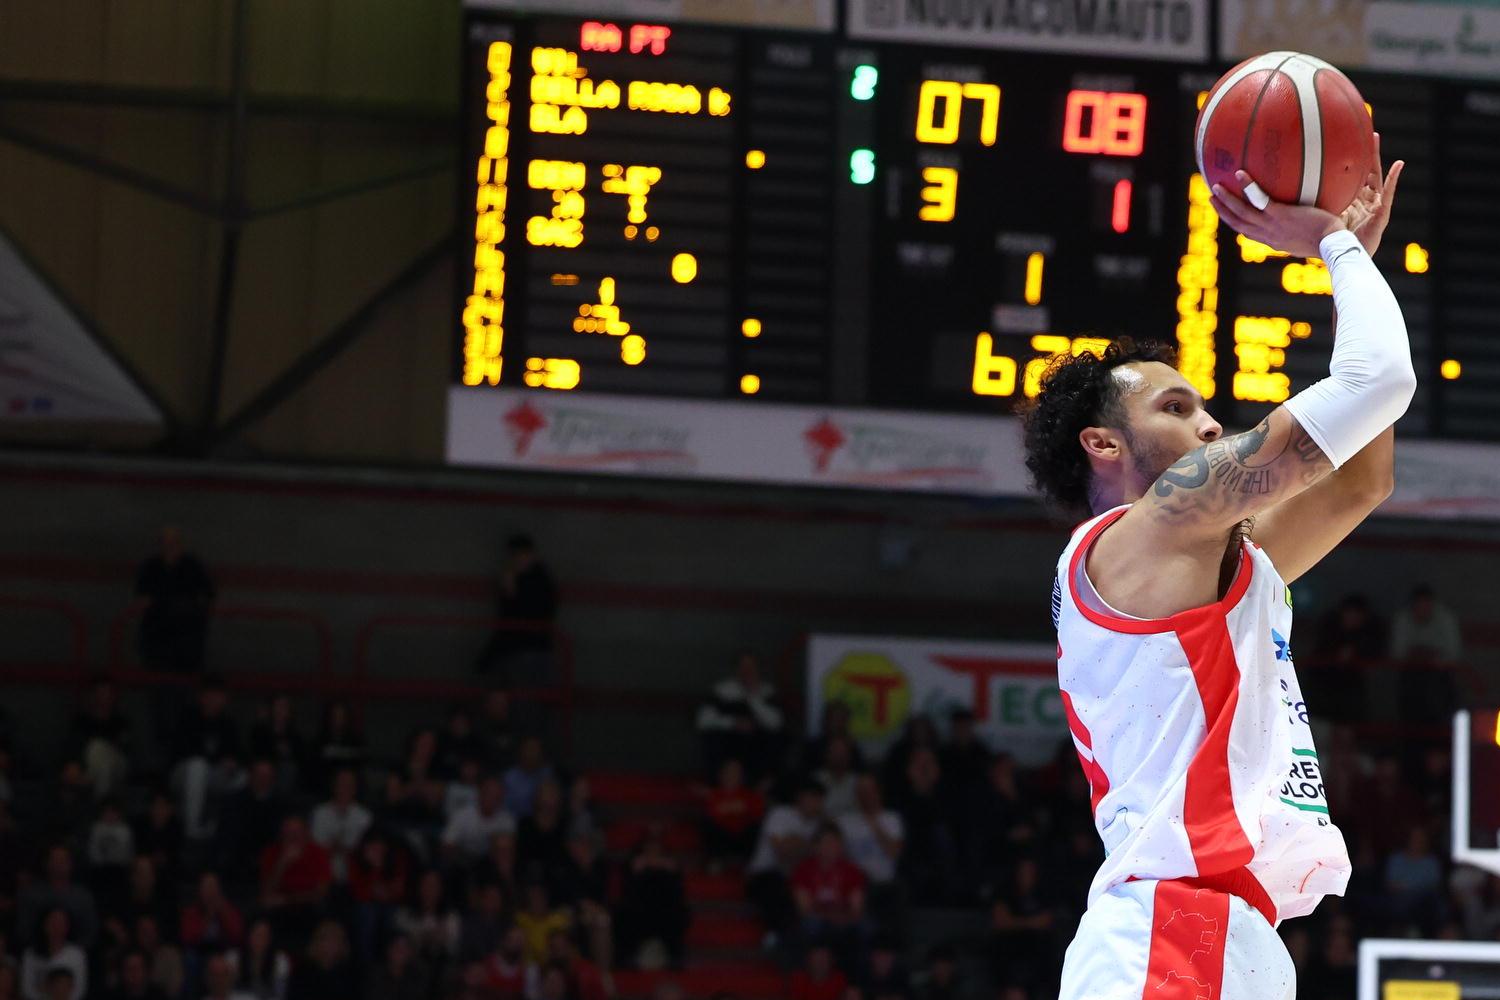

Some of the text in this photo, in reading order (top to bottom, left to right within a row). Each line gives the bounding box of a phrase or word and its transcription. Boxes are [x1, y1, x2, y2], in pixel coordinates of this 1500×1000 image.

[916, 80, 1001, 147] 07
[1063, 89, 1148, 156] 08
[918, 167, 959, 223] 3
[1025, 252, 1044, 306] 1
